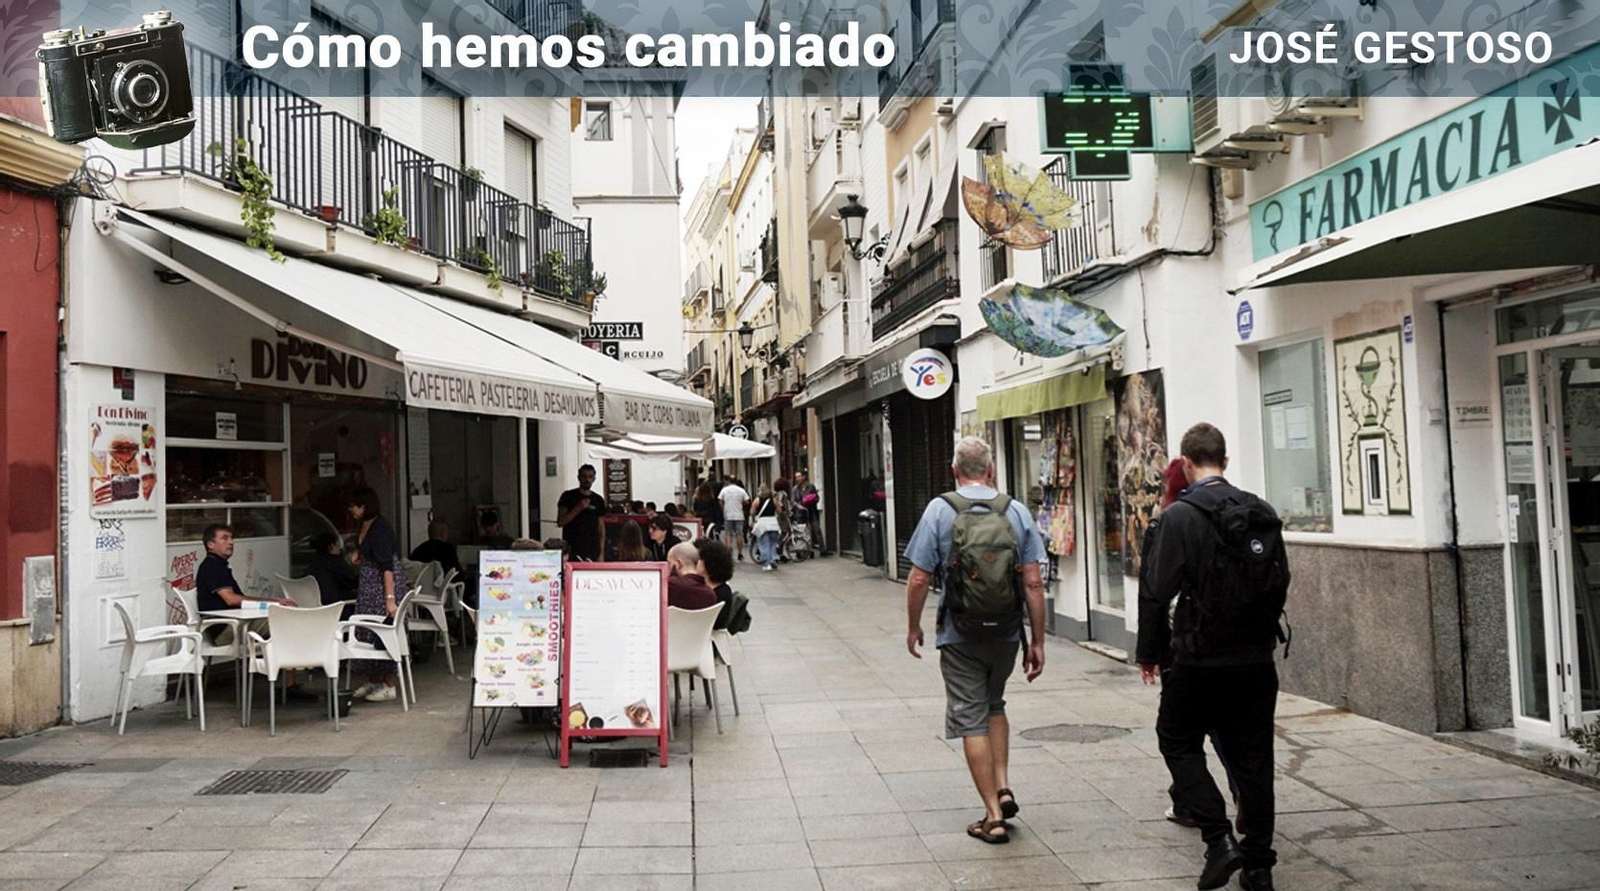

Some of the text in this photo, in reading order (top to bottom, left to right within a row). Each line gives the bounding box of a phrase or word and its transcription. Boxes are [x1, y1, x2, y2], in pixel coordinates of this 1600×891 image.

[1299, 97, 1522, 245] FARMACIA
[581, 324, 641, 338] JOYERIA
[251, 337, 368, 390] DIVINO
[409, 370, 596, 418] CAFETERIA PASTELERIA DESAYUNOS
[1455, 406, 1490, 415] TIMBRE
[624, 401, 639, 421] BAR
[641, 403, 652, 423] DE
[653, 405, 674, 425] COPAS
[575, 577, 653, 591] DESAYUNO
[547, 580, 560, 662] SMOOTHIES
